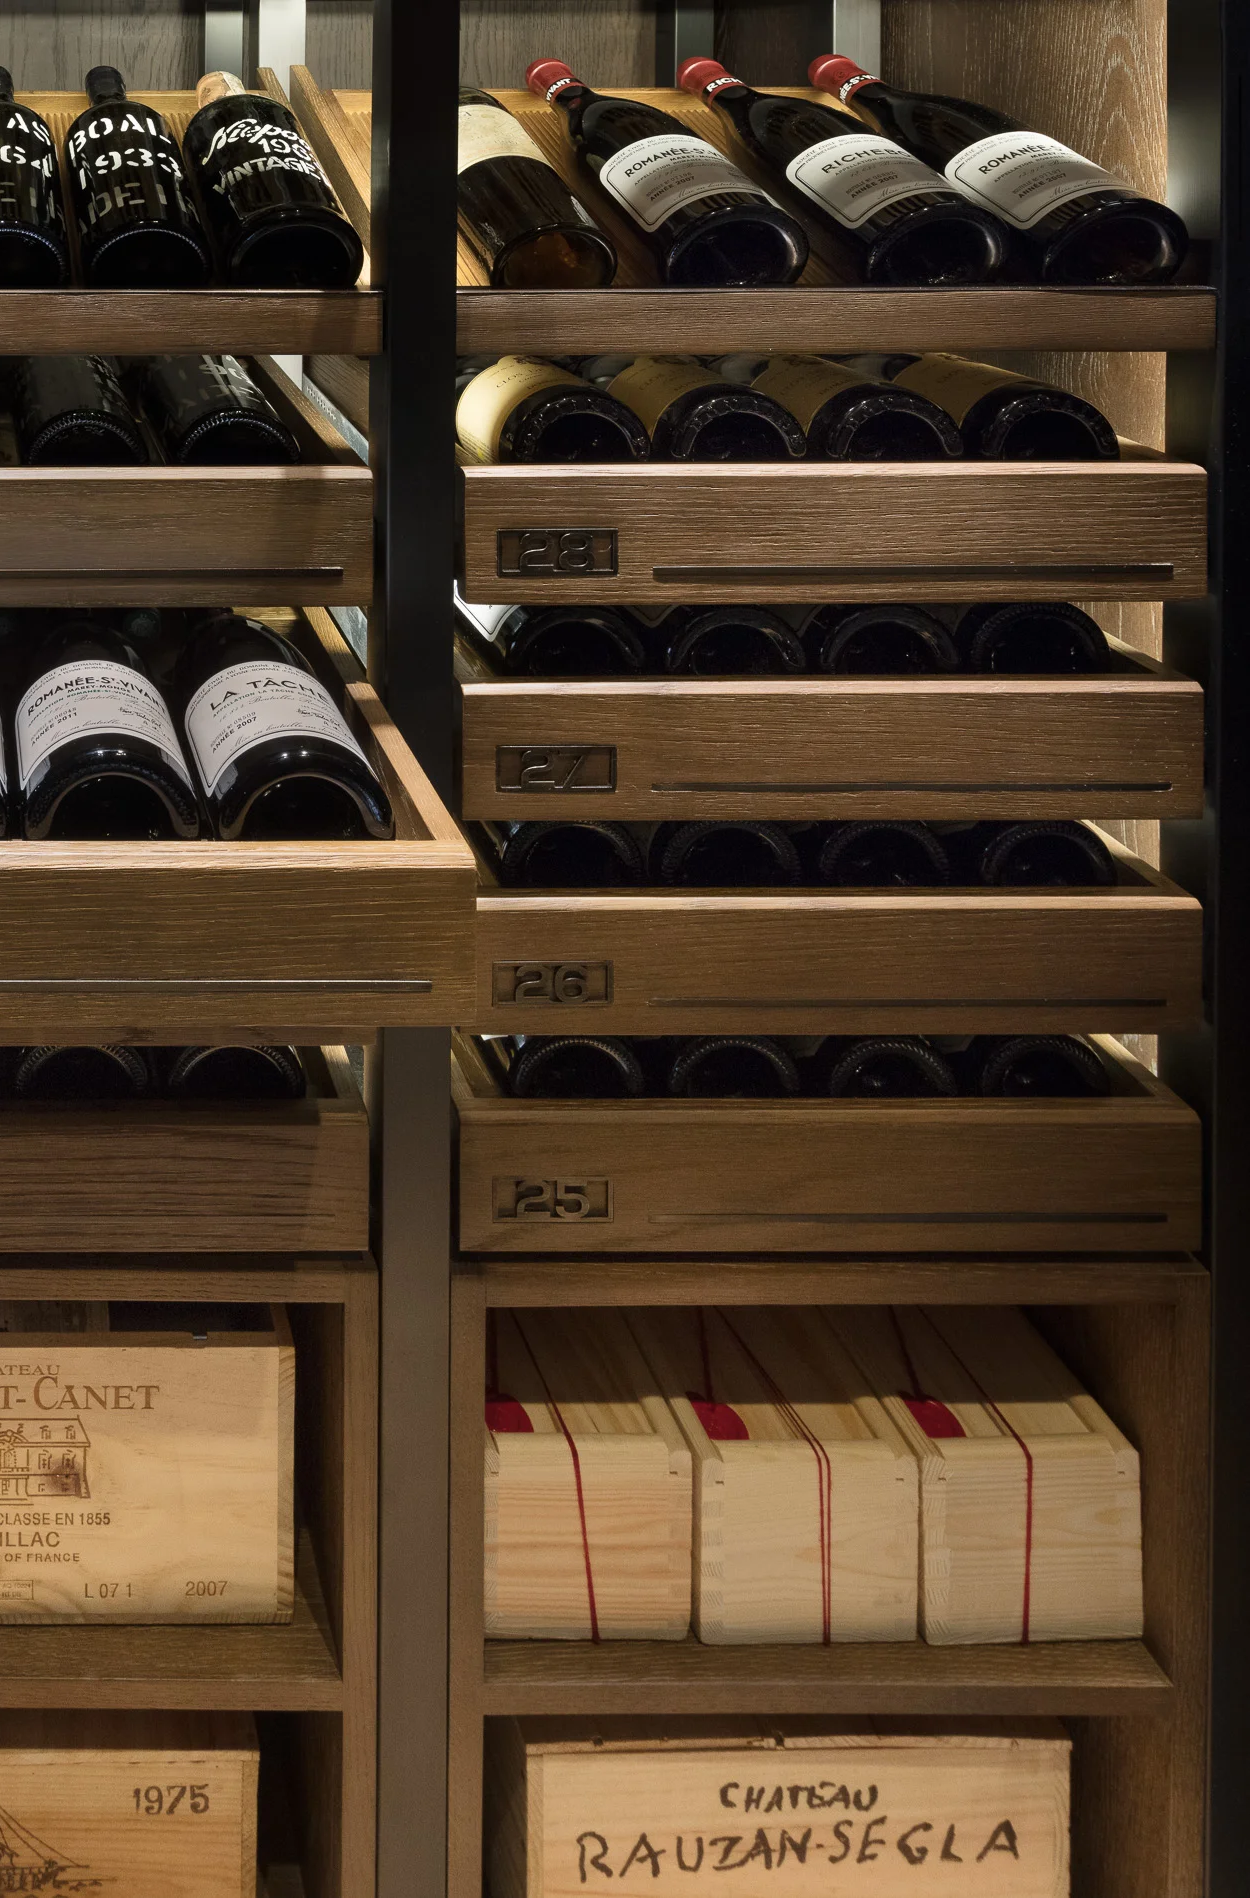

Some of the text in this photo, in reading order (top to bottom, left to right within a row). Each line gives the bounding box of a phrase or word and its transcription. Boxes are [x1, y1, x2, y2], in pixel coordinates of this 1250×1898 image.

[68, 113, 172, 160] BOAL
[79, 147, 182, 190] 1933
[835, 158, 877, 176] APPELLATION
[994, 161, 1033, 183] APPELLATION
[518, 532, 595, 573] 28
[67, 684, 132, 694] MAREY-MONGE
[210, 690, 240, 711] LA
[57, 712, 78, 724] 2011
[212, 692, 255, 718] APPELLATION
[212, 716, 258, 754] ANNÉE 2007
[519, 749, 585, 789] 27
[515, 964, 590, 1003] 26
[515, 1178, 590, 1218] 25
[54, 1512, 75, 1526] EN
[78, 1512, 111, 1526] 1855
[4, 1552, 22, 1563] OF
[26, 1552, 81, 1563] FRANCE
[185, 1580, 228, 1597] 2007
[132, 1783, 211, 1816] 1975
[718, 1781, 879, 1814] CHATEAU
